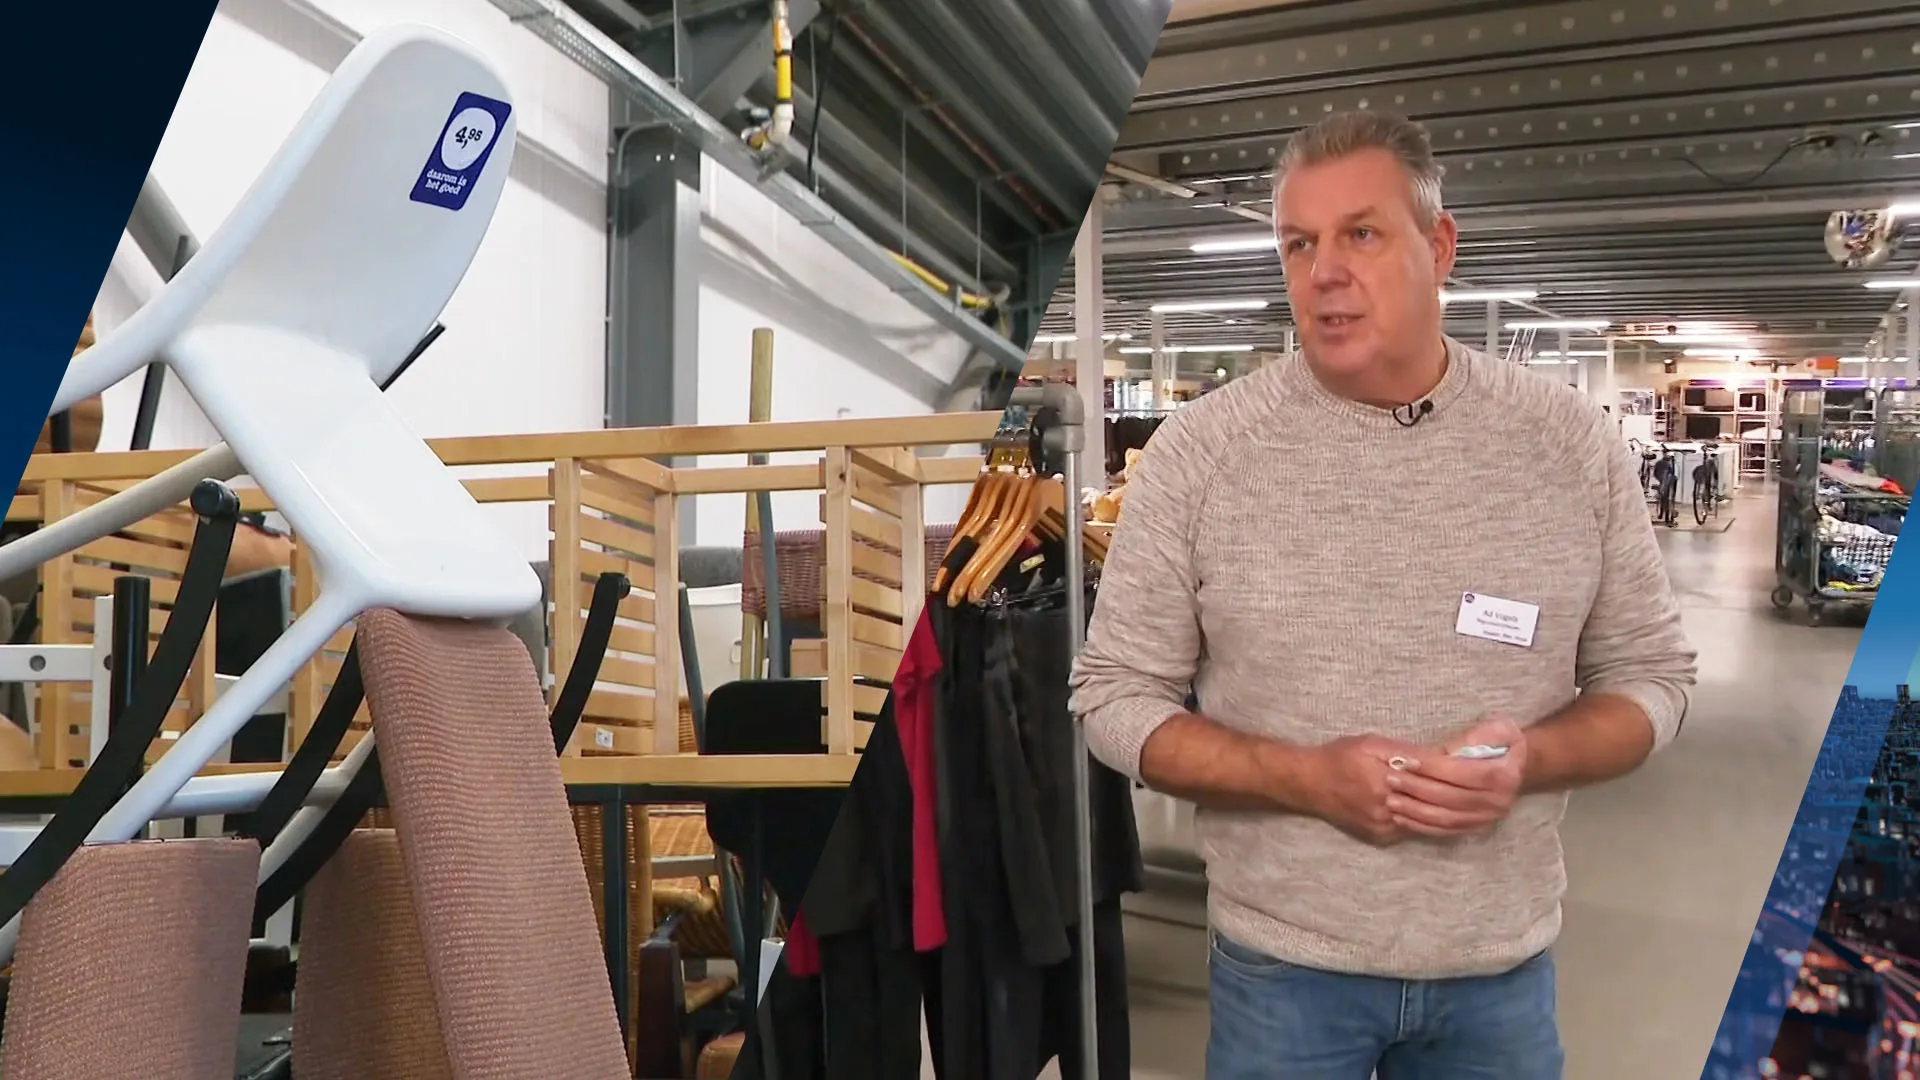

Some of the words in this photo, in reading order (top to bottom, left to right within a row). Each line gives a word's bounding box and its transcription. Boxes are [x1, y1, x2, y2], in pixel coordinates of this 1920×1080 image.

[455, 126, 483, 149] 4,95
[425, 179, 440, 190] het
[439, 183, 461, 195] goed
[427, 169, 458, 184] daarom
[459, 175, 467, 187] is
